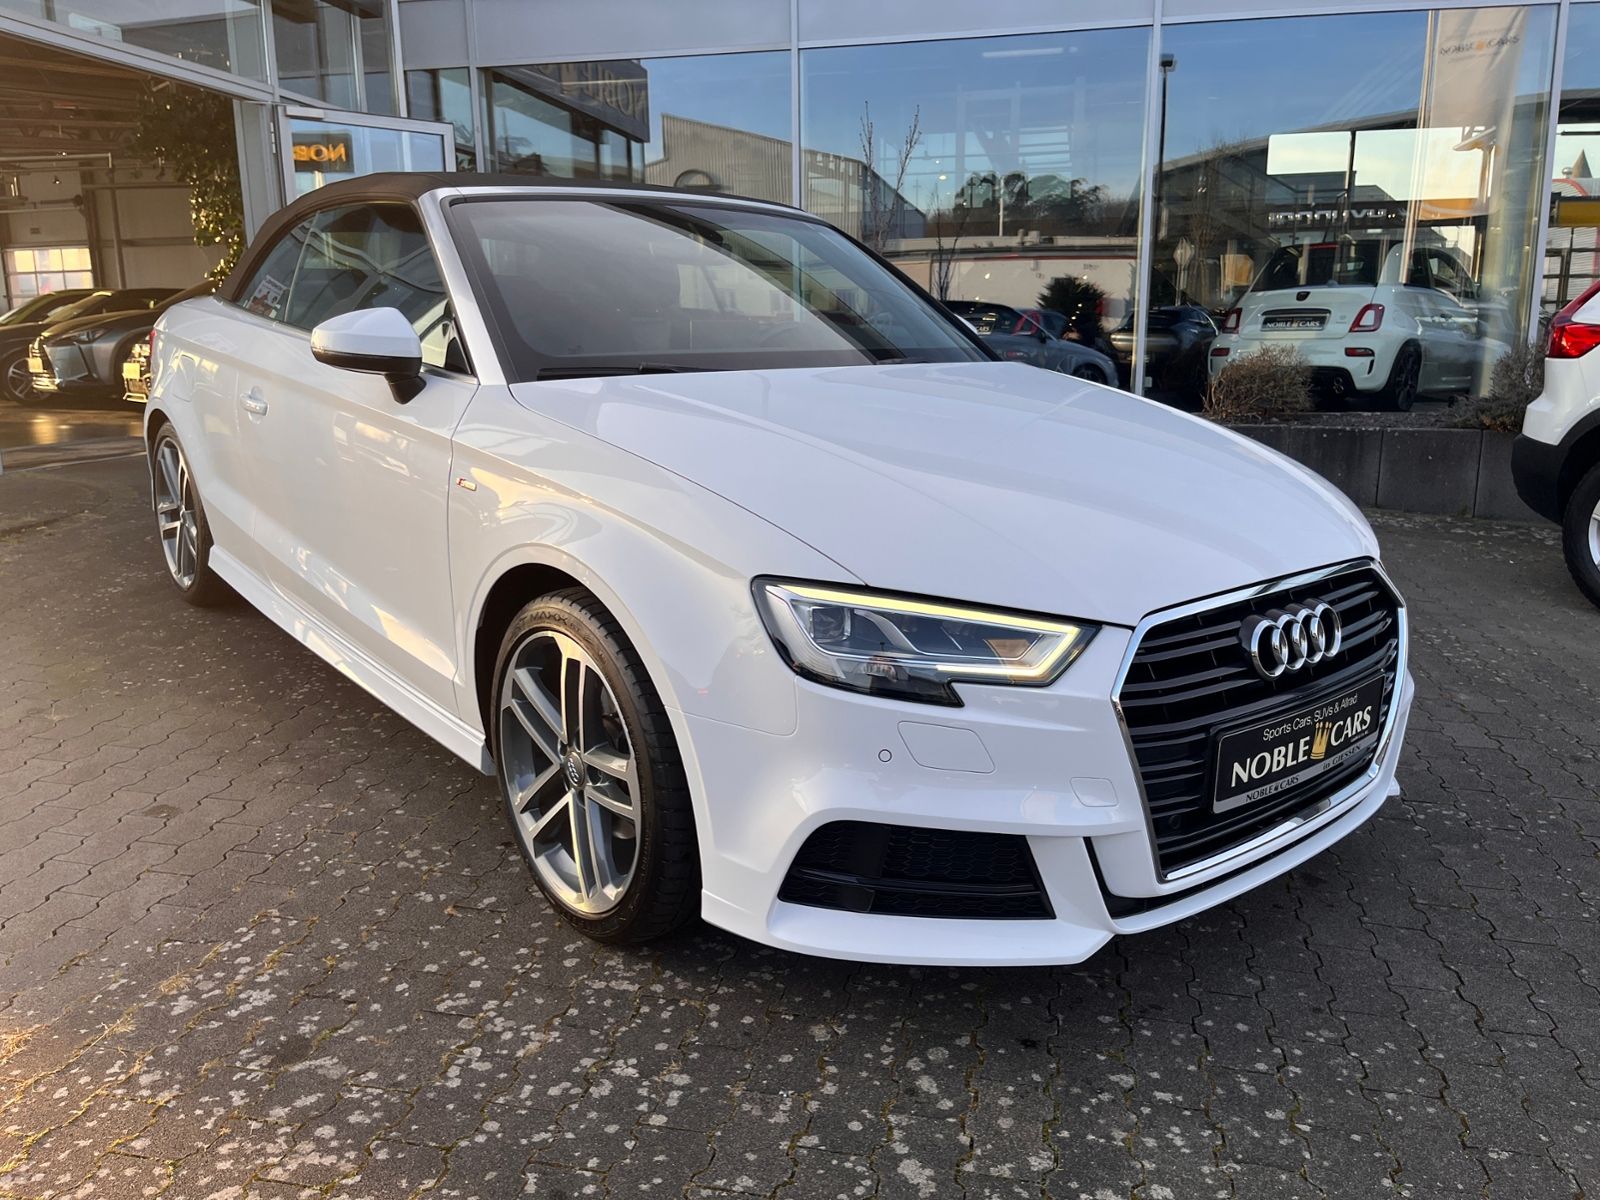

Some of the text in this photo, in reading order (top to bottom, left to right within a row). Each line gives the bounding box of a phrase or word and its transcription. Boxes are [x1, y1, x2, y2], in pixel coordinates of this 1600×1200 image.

[1263, 723, 1292, 741] Sports
[1293, 716, 1313, 730] Cars,
[1334, 702, 1339, 713] &
[1231, 705, 1373, 787] NOBLE CARS
[1245, 775, 1300, 802] NOBLE CARS
